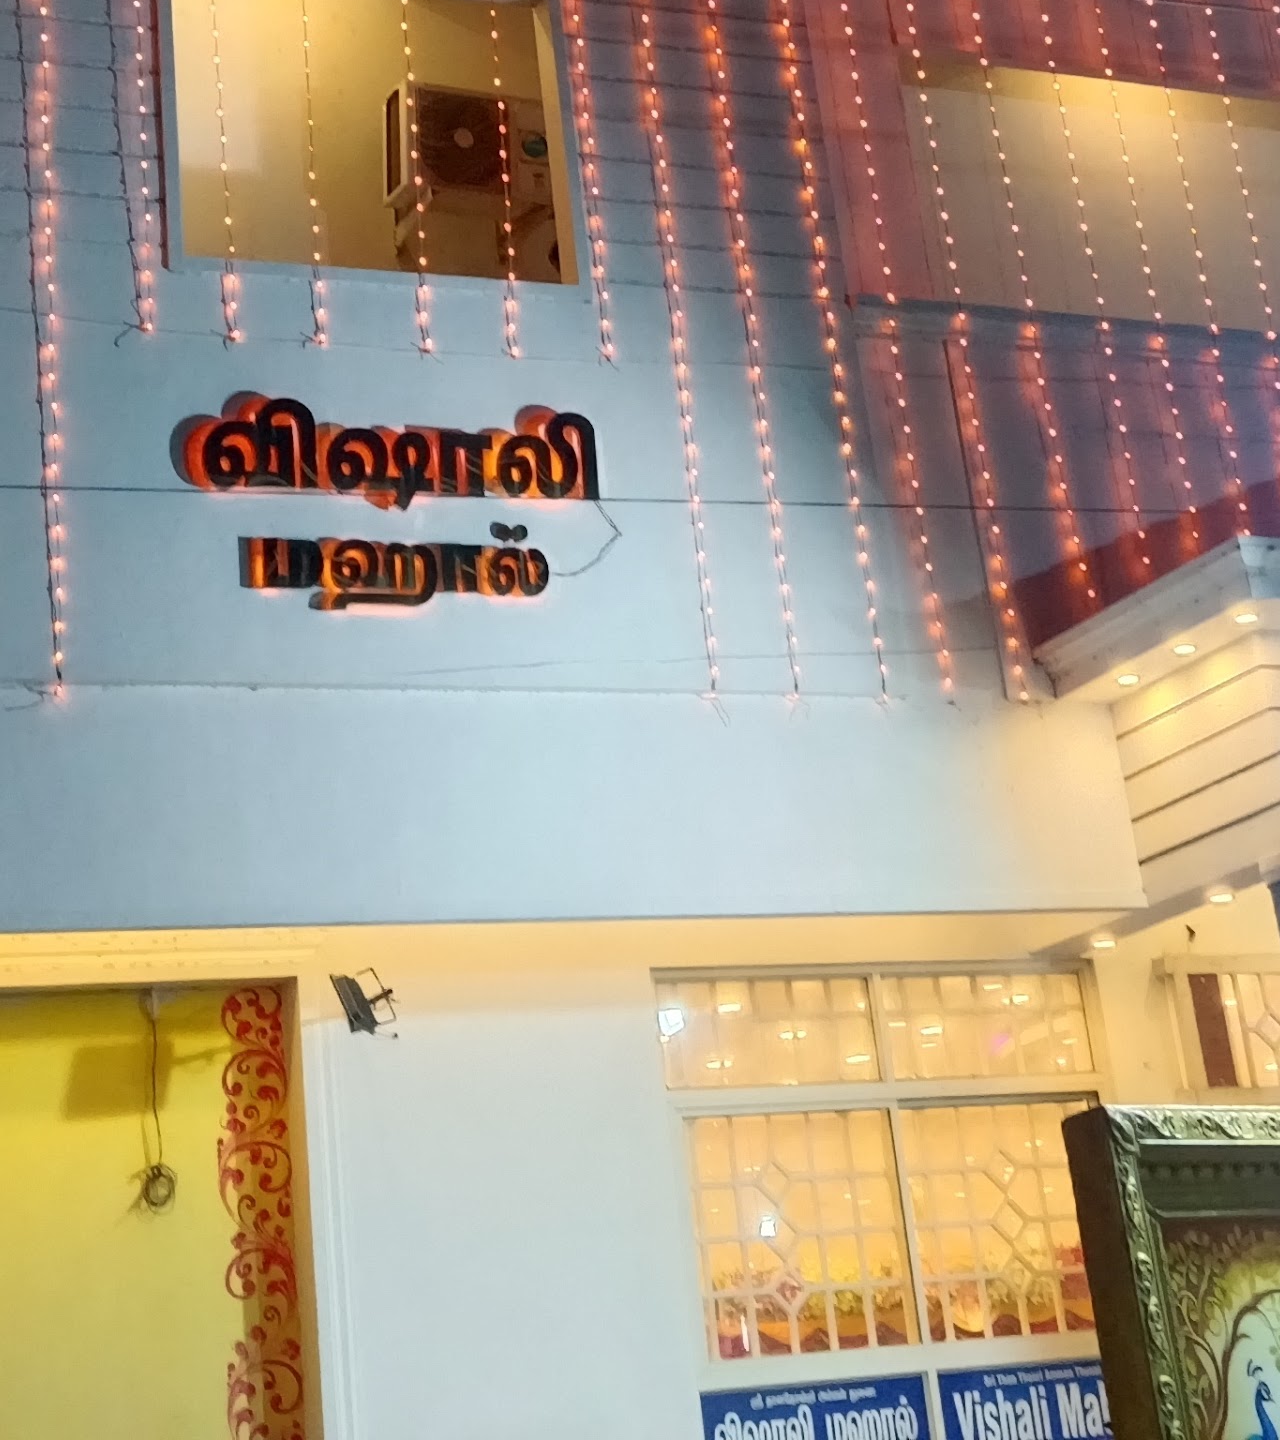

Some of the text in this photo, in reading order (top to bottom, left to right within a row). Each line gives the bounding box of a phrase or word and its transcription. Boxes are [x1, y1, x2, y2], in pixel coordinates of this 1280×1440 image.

[172, 391, 600, 511] விஷாலி
[238, 521, 549, 610] மஹால்
[952, 1384, 1054, 1440] Vishali
